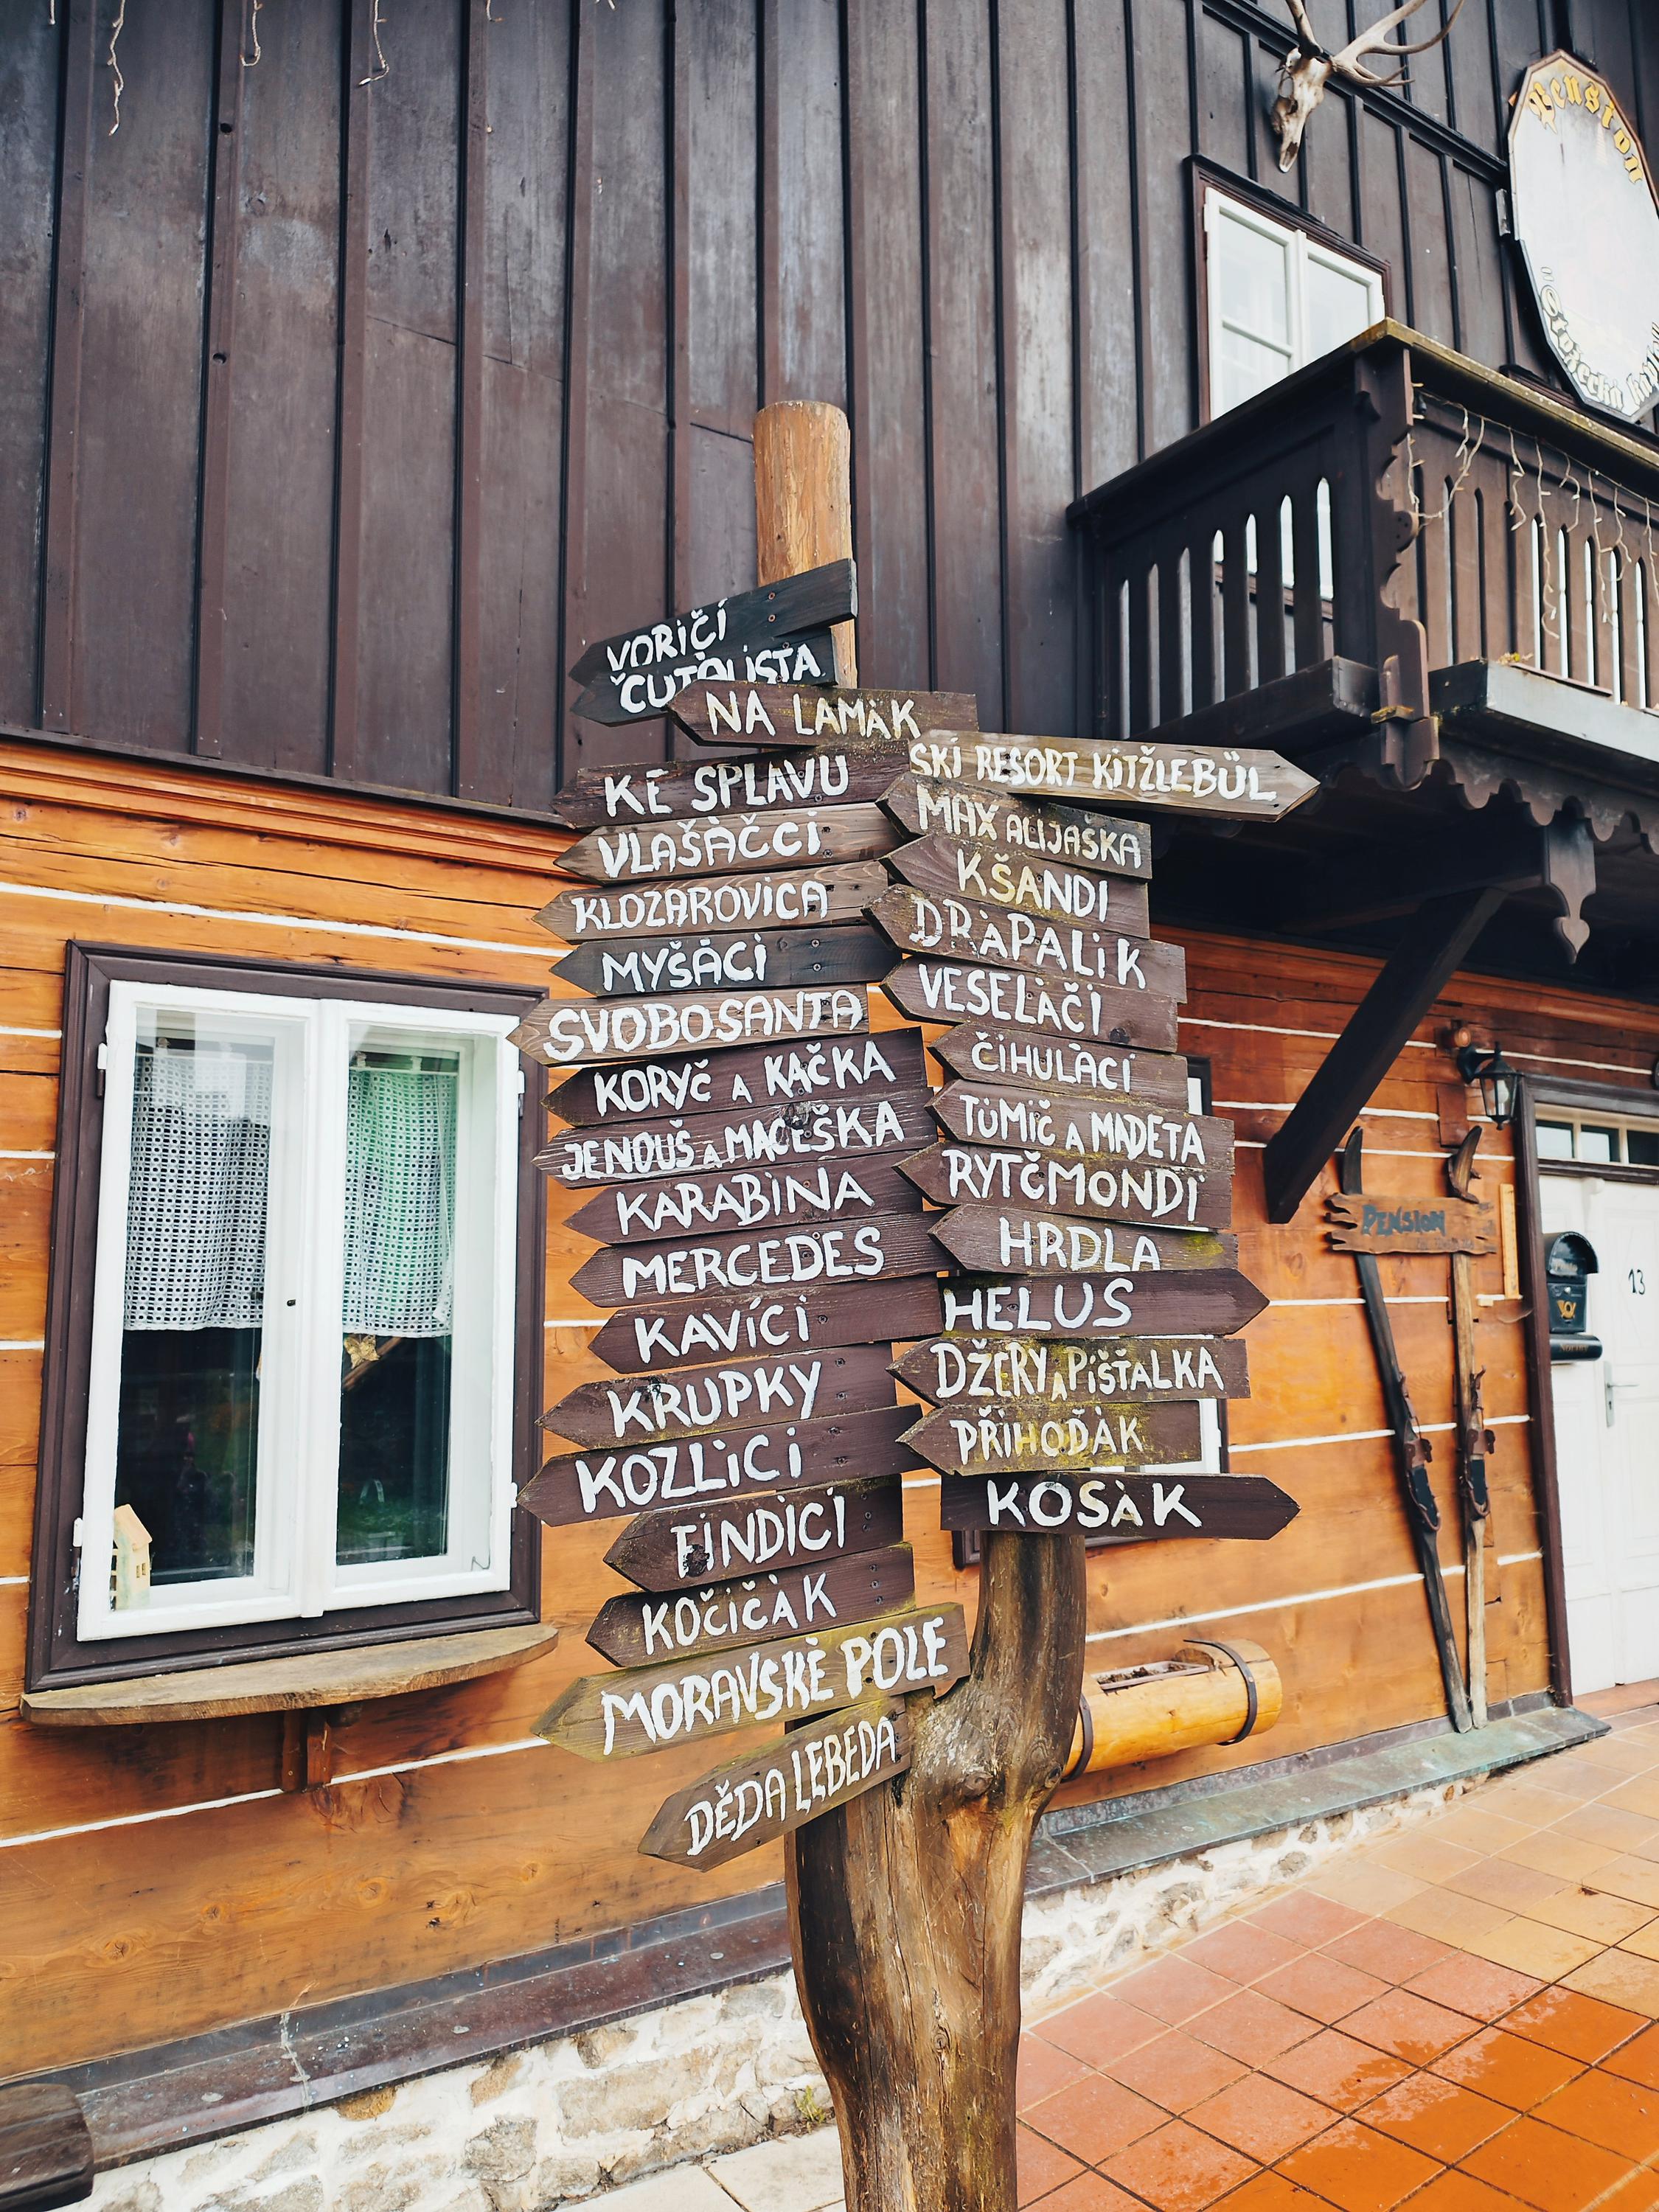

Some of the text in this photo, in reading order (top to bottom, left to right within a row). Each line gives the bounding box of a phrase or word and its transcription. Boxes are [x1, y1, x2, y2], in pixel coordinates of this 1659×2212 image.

[1528, 76, 1643, 184] Pension
[706, 689, 776, 736] NA
[691, 755, 849, 812] SPLAVU
[909, 737, 962, 779] SKI
[976, 745, 1078, 786] RESORT
[917, 783, 998, 841] MAX
[571, 876, 828, 933] KLOZAROVICA
[958, 849, 1108, 922] KŠANDI
[543, 990, 863, 1062] SVOBOSANTA
[594, 1040, 897, 1117] KORYČ A KAČKA
[561, 1119, 695, 1180] JENOUŠ
[1065, 1121, 1085, 1155] A
[1091, 1112, 1206, 1165] MADETA
[616, 1166, 875, 1236] KARABINA
[1361, 1204, 1446, 1237] PENSION
[622, 1225, 885, 1299] MERCEDES
[999, 1216, 1162, 1272] HRDLA
[942, 1277, 1134, 1332] HELUS
[1627, 1267, 1646, 1296] 13
[606, 1360, 822, 1438] KRUPKY
[930, 1338, 1048, 1399] DŽERY
[840, 1616, 949, 1699] POLE
[683, 1715, 897, 1857] DĚDA LEBEDA
